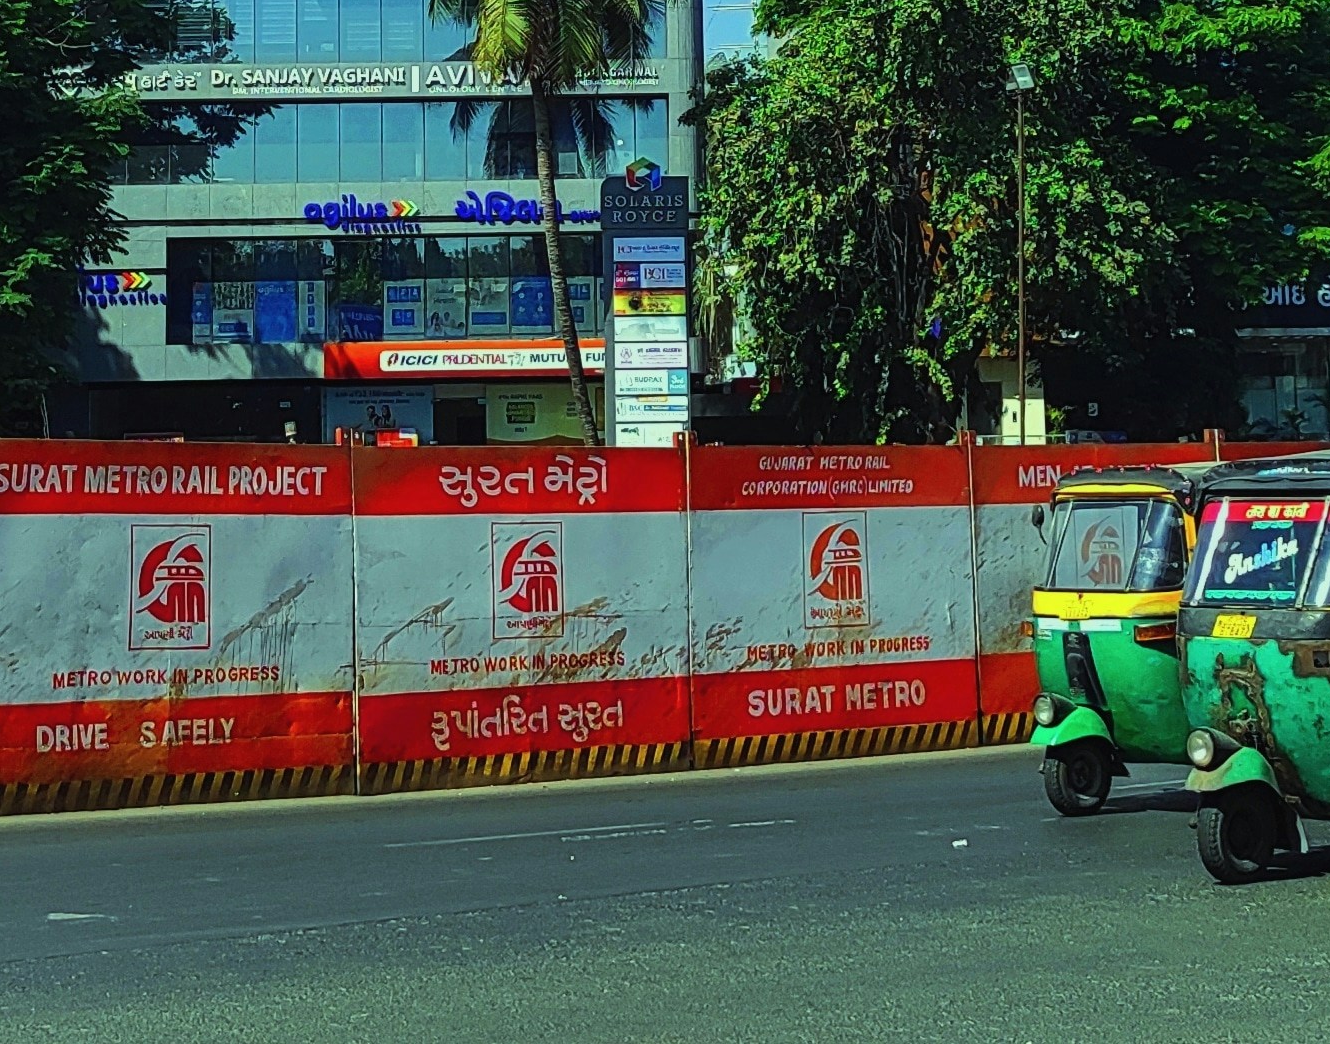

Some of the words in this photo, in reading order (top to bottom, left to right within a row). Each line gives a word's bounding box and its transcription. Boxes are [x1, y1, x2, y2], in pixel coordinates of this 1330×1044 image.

[210, 69, 237, 87] Dr.
[241, 66, 314, 86] SANJAY
[318, 66, 406, 85] VAGHANI
[303, 193, 390, 231] agilus
[603, 194, 684, 208] SOLARIS
[612, 210, 677, 223] ROYCE
[400, 352, 438, 366] ICICI
[758, 455, 812, 471] GUJARAT
[819, 455, 863, 470] METRO
[865, 455, 891, 470] RAIL
[83, 465, 168, 496] METRO
[170, 465, 224, 496] RAIL
[228, 465, 328, 496] PROJECT
[438, 465, 535, 508] સુરત
[741, 480, 828, 496] CORPORATION
[868, 479, 914, 494] LIMITED
[1018, 464, 1062, 488] MEN
[747, 643, 796, 660] METRO
[804, 639, 845, 657] WORK
[850, 639, 865, 656] IN
[869, 635, 931, 654] PROGRESS
[430, 657, 480, 675] METRO
[484, 656, 529, 672] WORK
[532, 655, 546, 670] IN
[550, 651, 626, 669] PROGRESS
[52, 669, 109, 690] METRO
[115, 668, 167, 686] WORK
[172, 668, 188, 685] IN
[193, 665, 280, 684] PROGRESS
[747, 684, 836, 717] SURAT
[845, 679, 927, 712] METRO
[558, 698, 625, 743] સુરત
[36, 722, 110, 753] DRIVE
[139, 717, 235, 749] SAFELY
